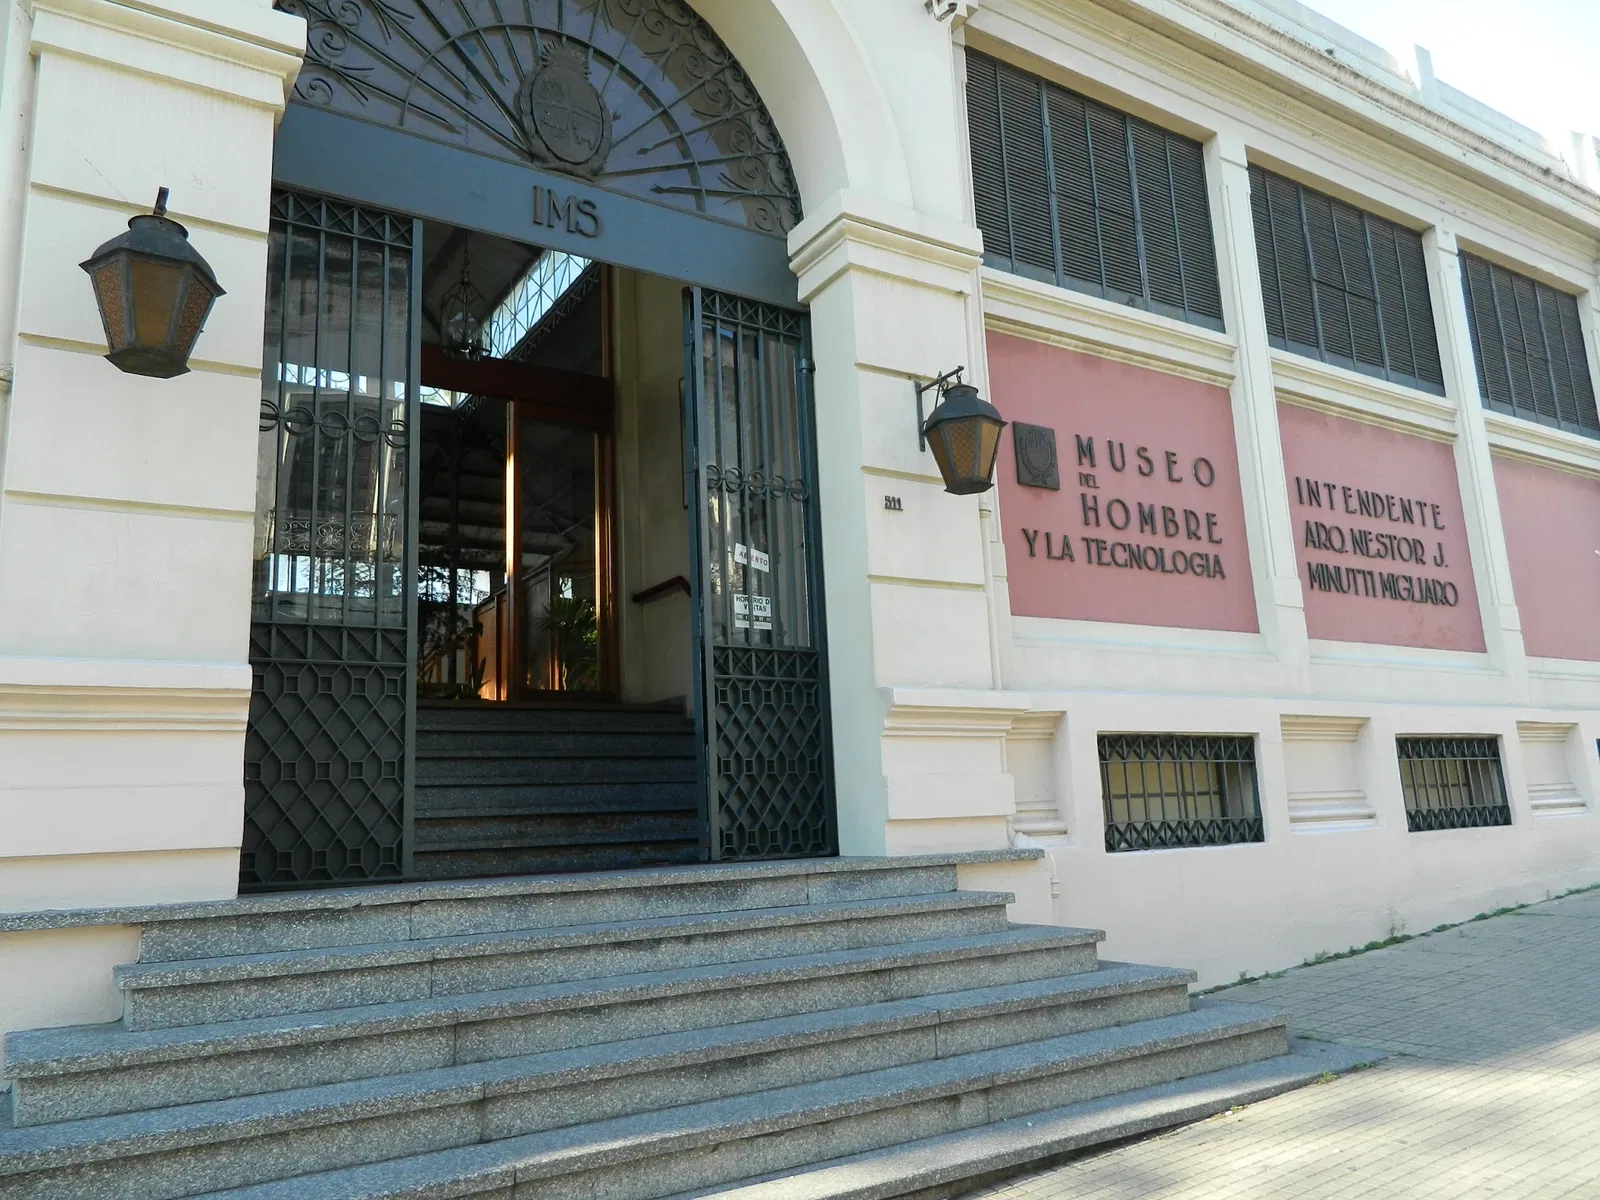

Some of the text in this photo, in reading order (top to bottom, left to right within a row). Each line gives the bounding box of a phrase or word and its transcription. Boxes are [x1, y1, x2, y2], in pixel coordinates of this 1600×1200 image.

[533, 185, 603, 238] IMS
[1075, 434, 1215, 487] MUSEO
[1078, 472, 1100, 489] DEL
[1080, 493, 1223, 544] HOMBRE
[1295, 476, 1446, 530] INTENDENTE
[739, 551, 768, 566] ABERTO
[1021, 528, 1226, 580] Y LA TECNOLOGIA
[1350, 528, 1427, 565] NESTOR
[1433, 542, 1448, 568] J.
[736, 596, 763, 605] HORRIO
[1307, 561, 1459, 607] MINUTTI MIGLIARO
